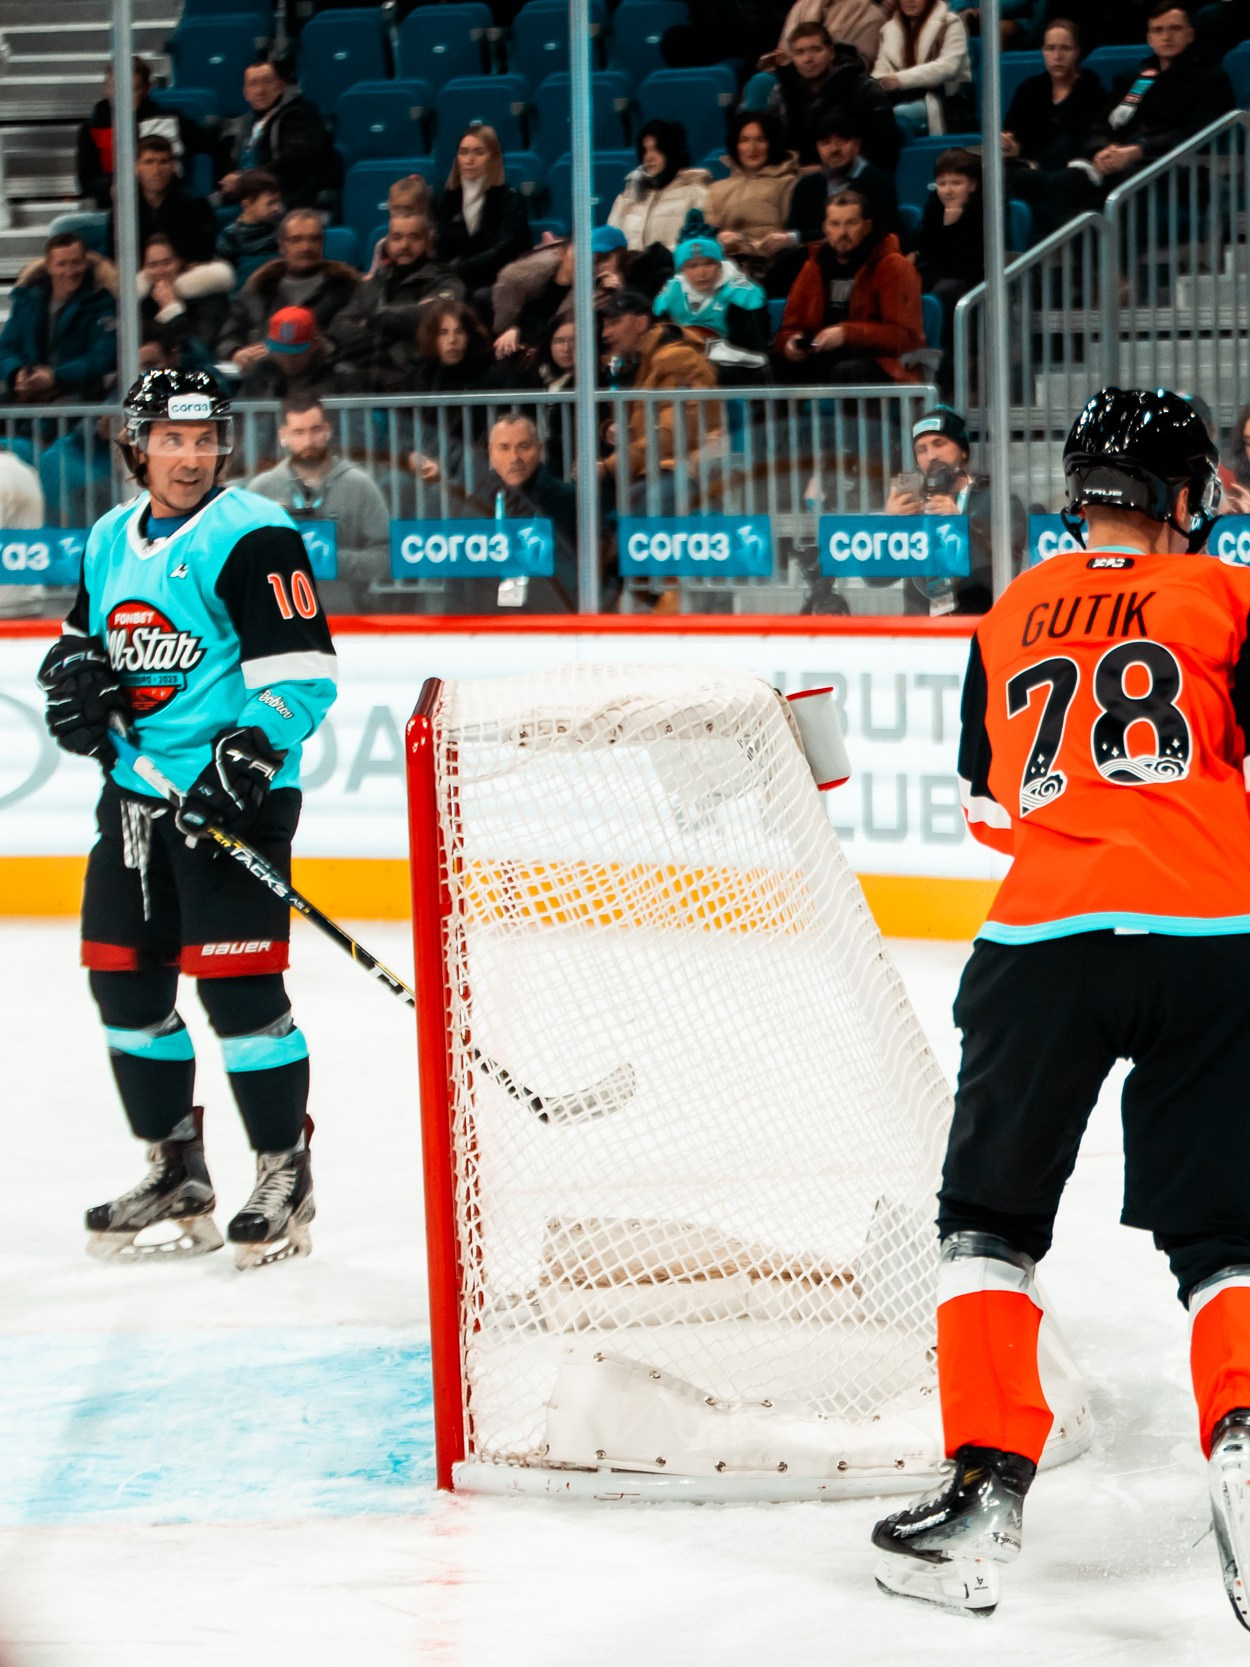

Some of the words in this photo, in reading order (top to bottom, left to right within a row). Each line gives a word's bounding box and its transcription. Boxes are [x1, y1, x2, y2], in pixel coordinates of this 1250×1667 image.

[1083, 488, 1122, 497] TRUE
[401, 532, 510, 563] согаз
[627, 530, 730, 561] согаз
[829, 530, 929, 561] согаз
[267, 570, 317, 620] 10
[114, 611, 155, 625] FONBET
[1022, 591, 1156, 647] GUTIK
[106, 627, 202, 672] ll-Star
[258, 689, 294, 720] Bobrov
[1006, 639, 1193, 818] 78
